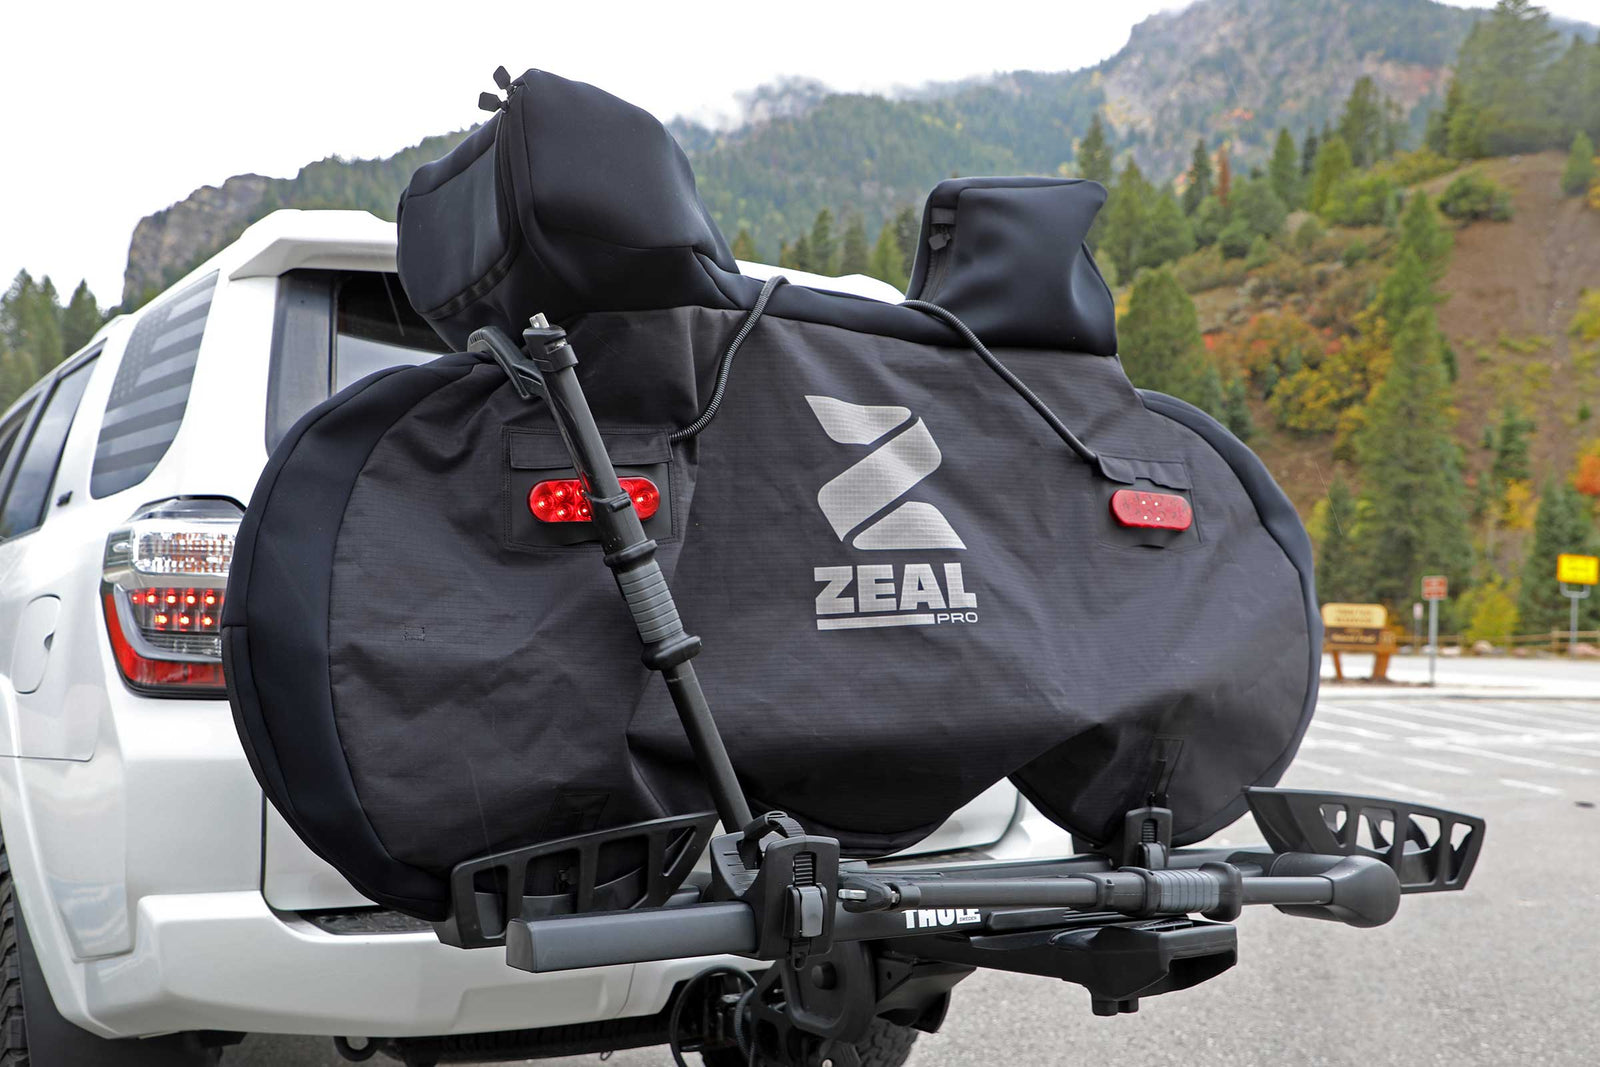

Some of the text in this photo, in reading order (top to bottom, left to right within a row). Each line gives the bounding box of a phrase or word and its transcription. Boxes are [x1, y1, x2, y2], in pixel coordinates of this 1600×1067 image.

[813, 562, 978, 615] ZEAL
[937, 611, 979, 624] PRO
[901, 908, 982, 929] THULE
